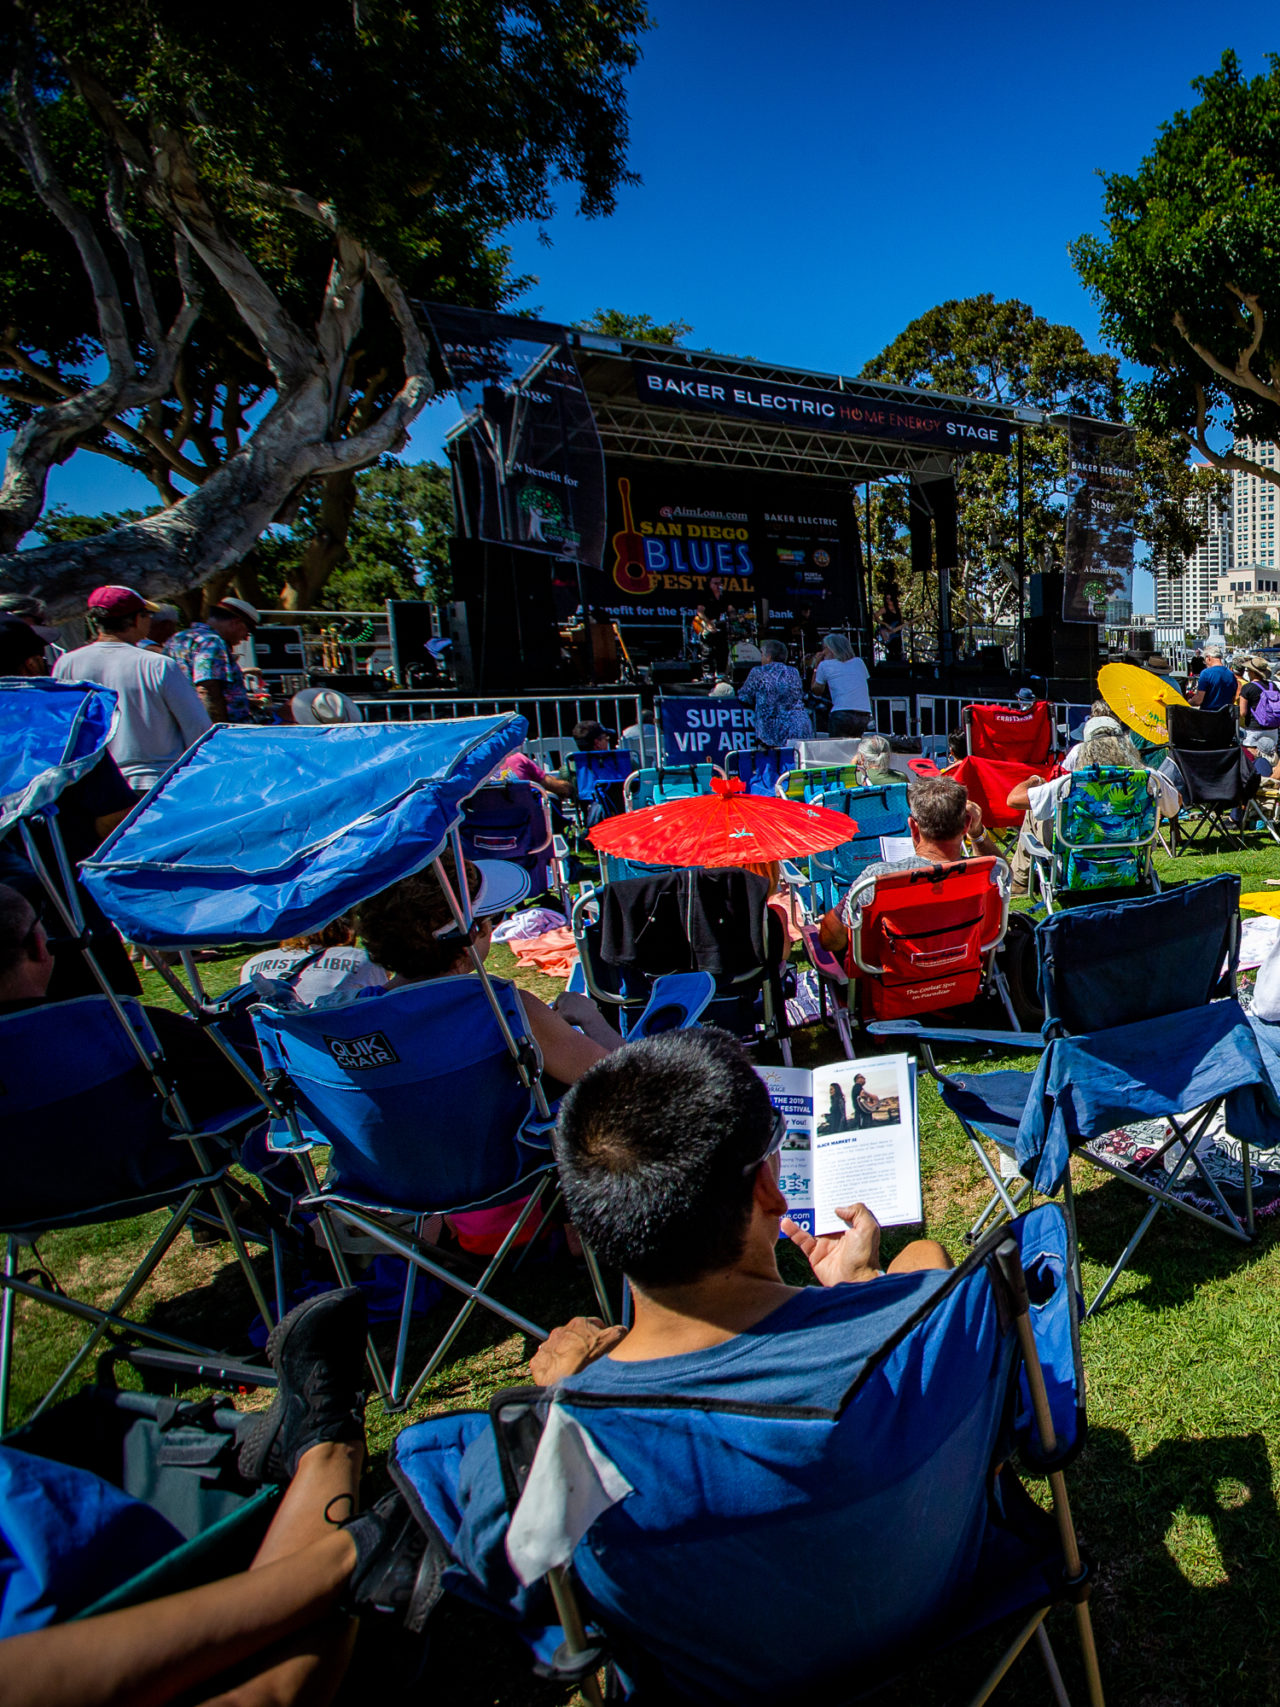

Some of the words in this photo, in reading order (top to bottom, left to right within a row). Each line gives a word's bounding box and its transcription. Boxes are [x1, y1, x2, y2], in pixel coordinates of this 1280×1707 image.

[646, 375, 726, 401] BAKER
[734, 389, 836, 418] ELECTRIC
[840, 405, 886, 425] HOME
[889, 413, 942, 432] ENERGY
[946, 422, 999, 442] STAGE
[525, 463, 562, 482] benefit
[563, 474, 579, 487] for
[1071, 461, 1098, 473] BAKER
[1100, 465, 1135, 479] ELECTRIC
[673, 506, 749, 523] AimLoan.com
[1091, 498, 1117, 514] Stage
[764, 512, 796, 523] BAKER
[798, 516, 838, 527] ELECTRIC
[639, 520, 682, 537] SAN
[687, 524, 749, 541] DIEGO
[643, 537, 754, 576] BLUES
[647, 572, 755, 593] FESTVAL
[636, 605, 655, 616] for
[657, 606, 681, 617] the
[768, 609, 794, 620] Bank
[686, 708, 756, 729] SUPER
[673, 731, 712, 752] VIP
[718, 731, 757, 751] ARE
[249, 957, 303, 976] TURIST
[312, 957, 361, 975] LIBRE
[330, 1035, 385, 1058] QUIK
[337, 1051, 393, 1068] CHAIR
[773, 1096, 788, 1104] THE
[788, 1097, 805, 1105] 2019
[780, 1105, 811, 1113] FESTIVAL
[791, 1118, 807, 1126] You!
[831, 1138, 851, 1146] MARKET
[778, 1178, 812, 1191] BEST
